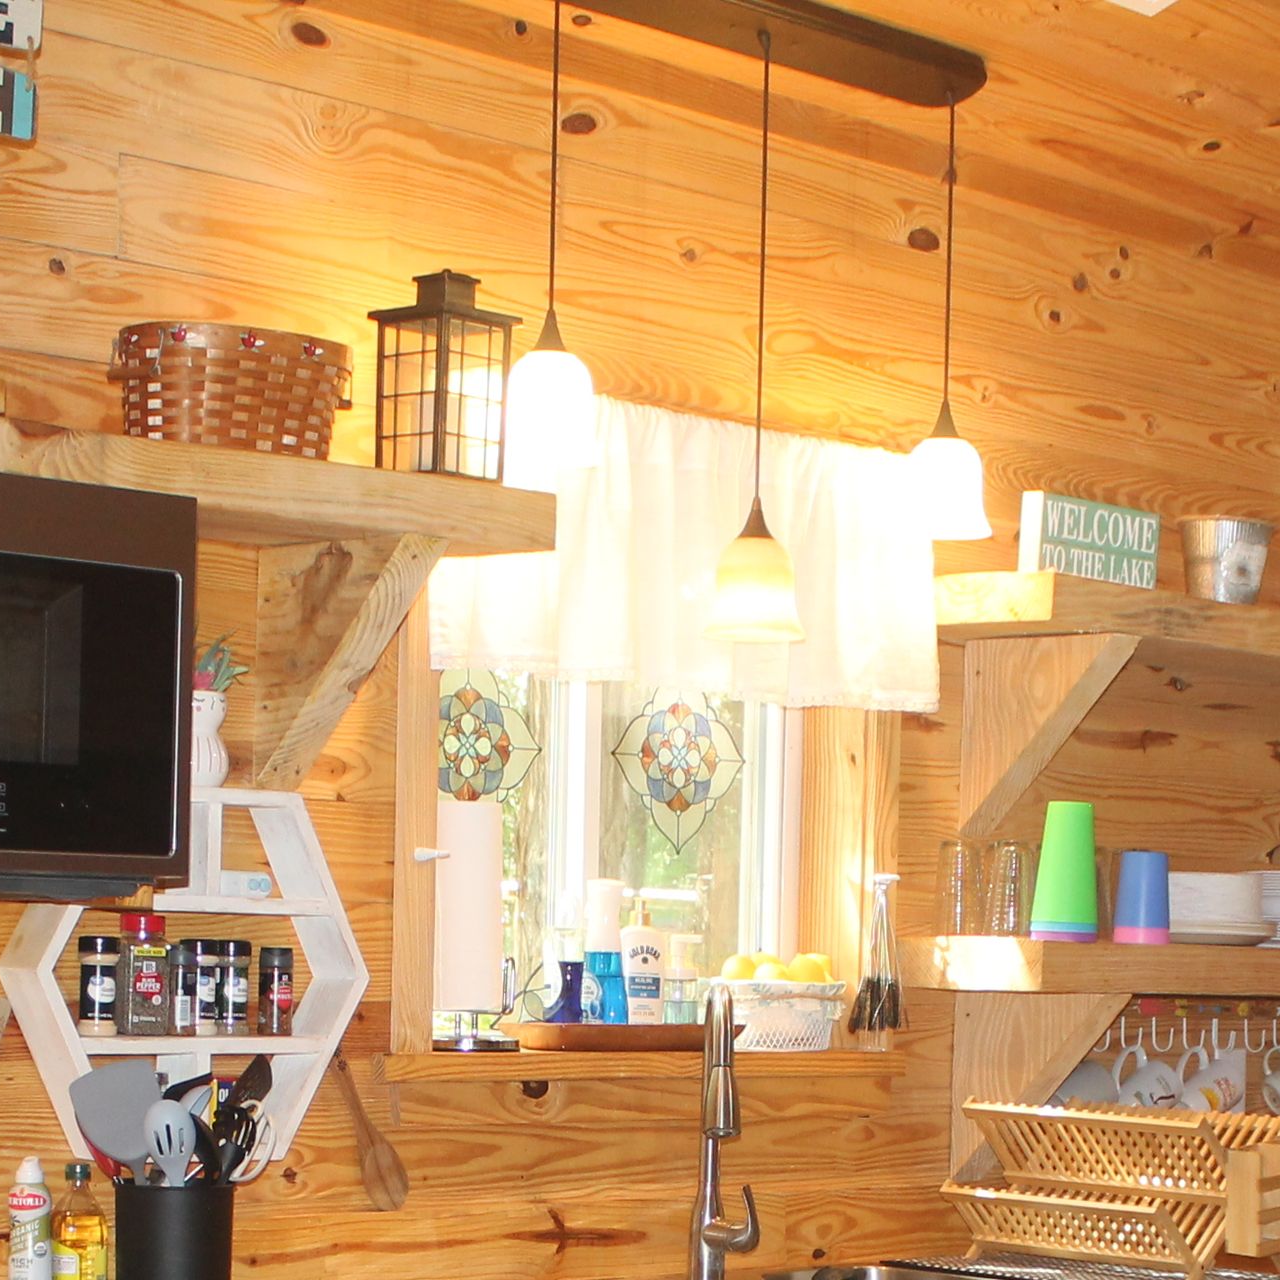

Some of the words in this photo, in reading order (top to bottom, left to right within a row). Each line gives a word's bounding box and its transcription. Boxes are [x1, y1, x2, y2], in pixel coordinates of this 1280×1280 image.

[1046, 500, 1157, 554] WELCOME
[1042, 543, 1066, 574] TO
[1070, 549, 1105, 581] THE
[1108, 554, 1155, 590] LAKE
[136, 982, 161, 990] PEPPER
